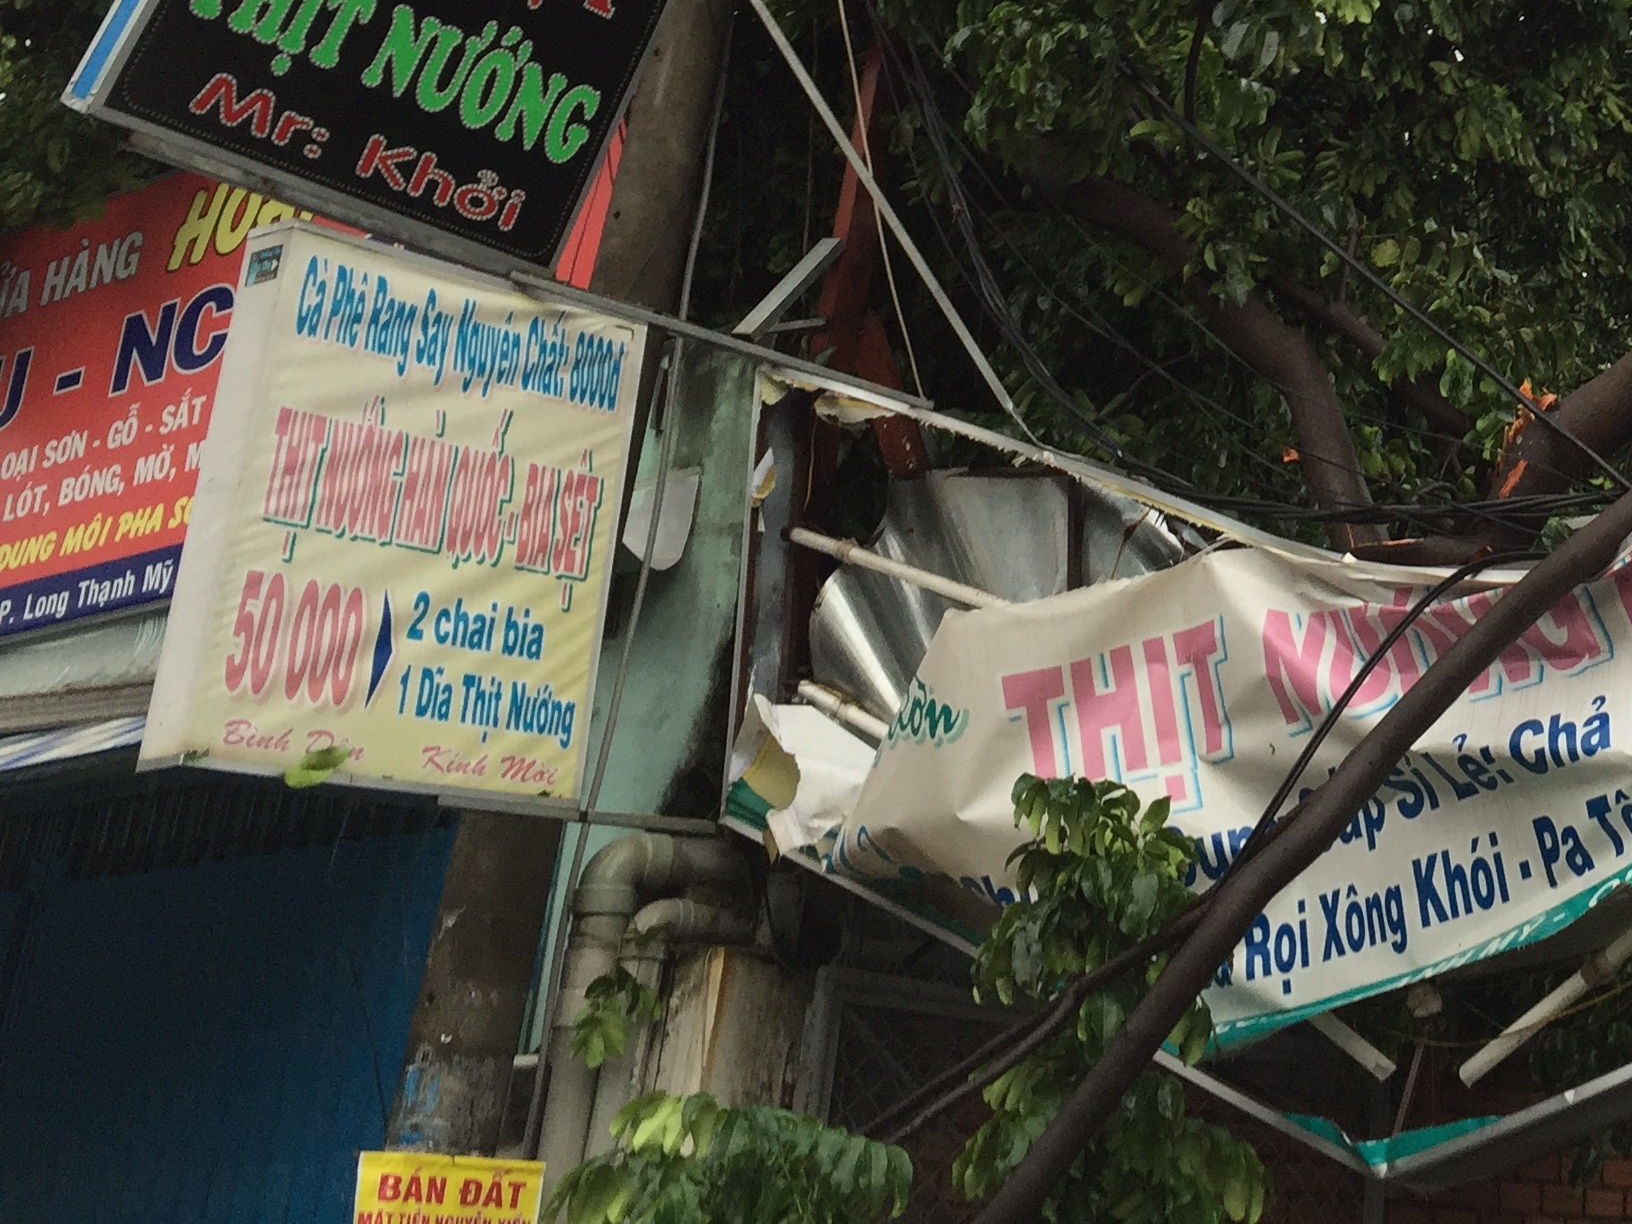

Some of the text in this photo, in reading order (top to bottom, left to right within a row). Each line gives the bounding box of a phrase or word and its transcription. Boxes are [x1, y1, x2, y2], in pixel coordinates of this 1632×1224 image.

[360, 3, 602, 164] NƯỚNG
[189, 72, 527, 232] Mr: Khởi
[39, 230, 144, 307] HÀNG
[295, 255, 329, 338] Cà
[323, 264, 370, 348] Phê
[363, 274, 419, 378] Rang
[415, 287, 455, 386] Say
[42, 430, 88, 468] SƠN
[106, 401, 141, 450] GỖ
[159, 387, 208, 434] SẮT
[114, 502, 165, 543] PHA
[263, 406, 333, 563] THỊT
[515, 462, 562, 576] BIA
[23, 590, 70, 620] Long
[77, 570, 136, 609] Thạnh
[141, 559, 175, 595] Mỹ
[406, 591, 547, 661] 2 chai bia
[222, 719, 295, 753] Bình
[305, 729, 366, 762] Dn
[397, 664, 577, 750] 1 Dĩa Thịt Nướng
[1001, 615, 1235, 816] THỊT
[1509, 695, 1612, 770] Chả
[1243, 898, 1311, 996] Rọi
[1317, 883, 1410, 955] Xông
[1411, 830, 1511, 929] Khói
[1532, 814, 1597, 889] Pa
[377, 1167, 528, 1210] BÁN ĐẤT
